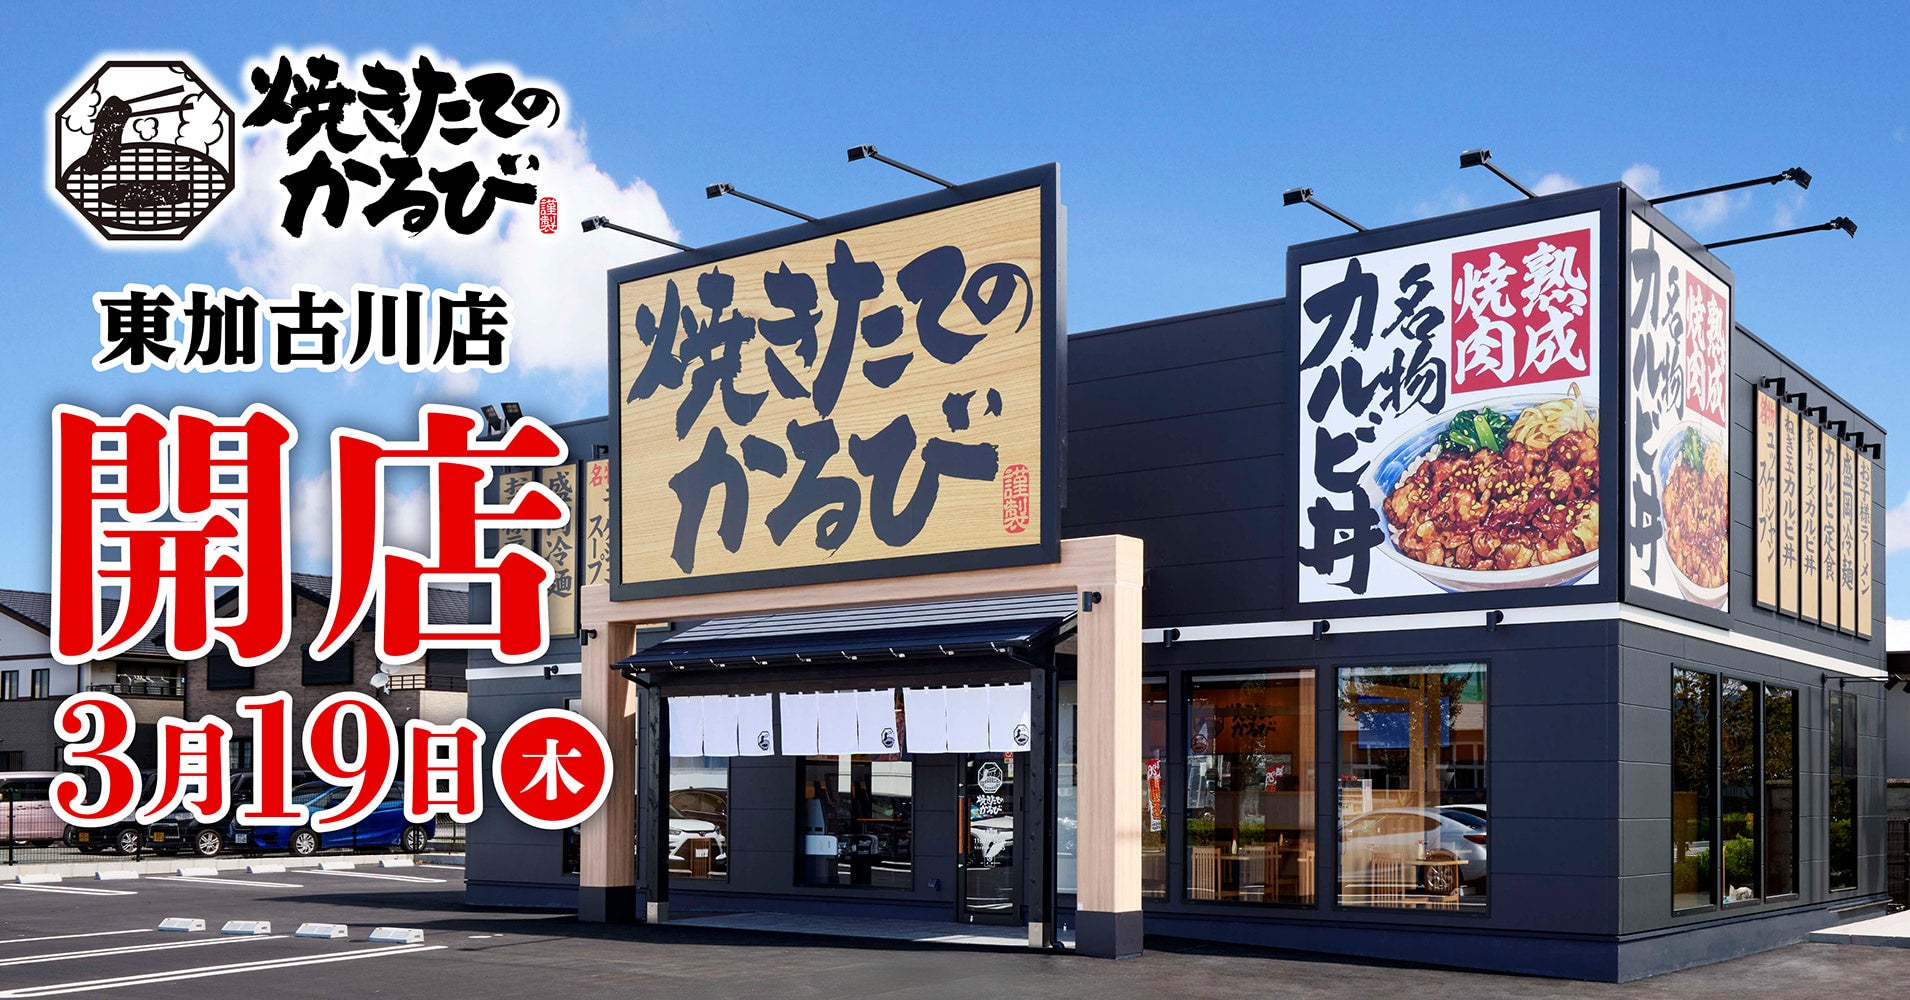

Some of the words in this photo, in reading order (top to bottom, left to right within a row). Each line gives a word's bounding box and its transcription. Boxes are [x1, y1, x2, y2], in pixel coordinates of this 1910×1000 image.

[627, 239, 1034, 440] 焼きたての
[1381, 262, 1447, 418] 名物
[1454, 251, 1517, 385] 焼肉
[1519, 241, 1588, 377] 熟成
[1658, 265, 1685, 421] 名物
[1686, 284, 1706, 405] 焼肉
[1706, 294, 1727, 423] 熟成
[668, 388, 1003, 574] かるび
[1300, 257, 1387, 595] カルビ丼
[1630, 229, 1663, 586] カルビ丼
[1003, 464, 1030, 533] 謹製
[1823, 442, 1836, 583] カルビ定食
